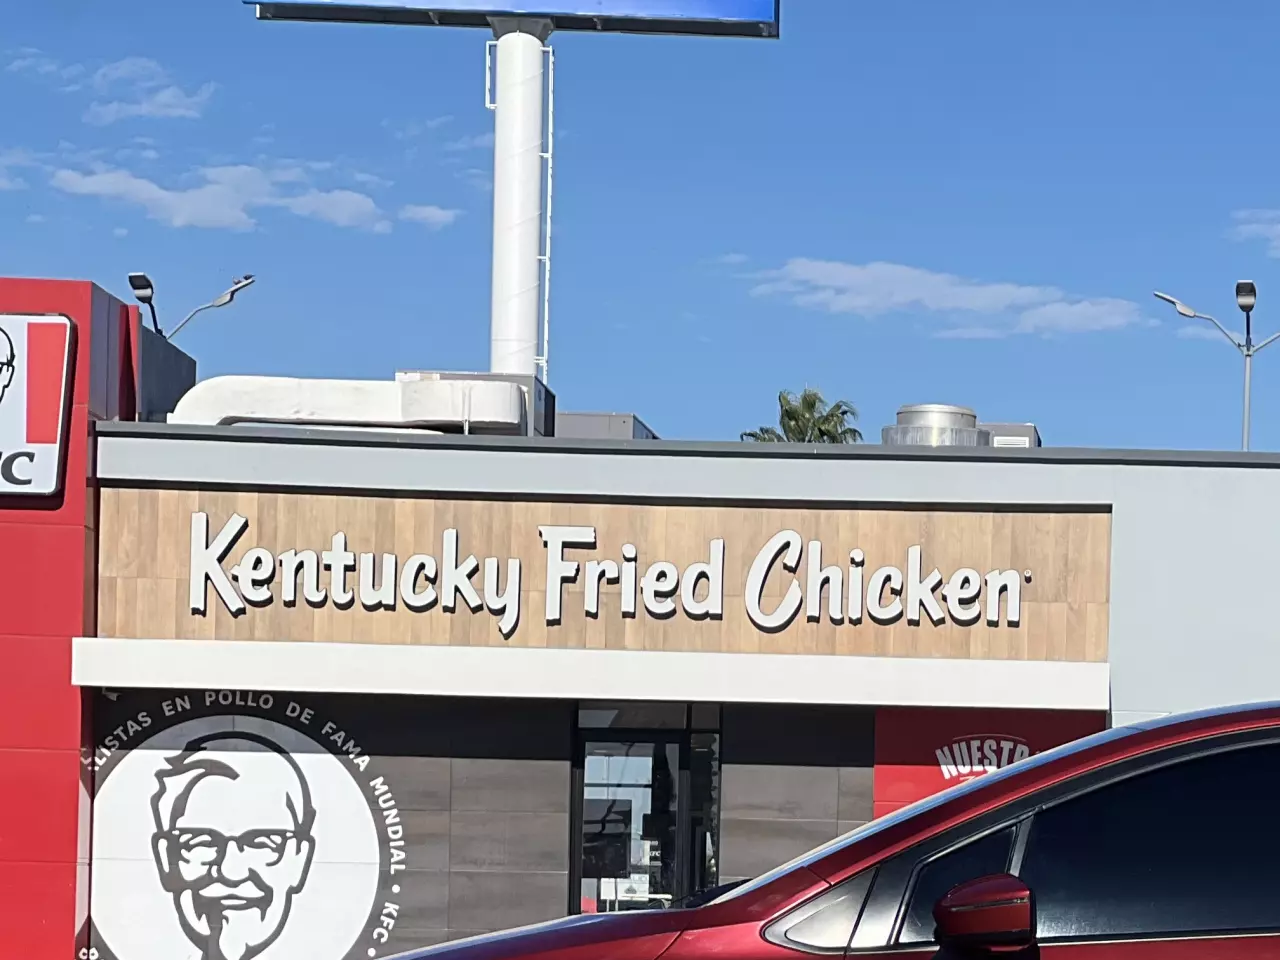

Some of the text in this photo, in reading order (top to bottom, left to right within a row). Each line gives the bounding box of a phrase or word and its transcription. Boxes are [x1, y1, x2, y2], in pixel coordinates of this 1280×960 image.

[0, 451, 35, 485] C
[189, 511, 521, 639] Kentucky
[537, 525, 724, 626] Fried
[935, 739, 1040, 780] NUESTR
[94, 690, 406, 944] LISTAS EN POLLO DE FAMA MUNDIAL KFC
